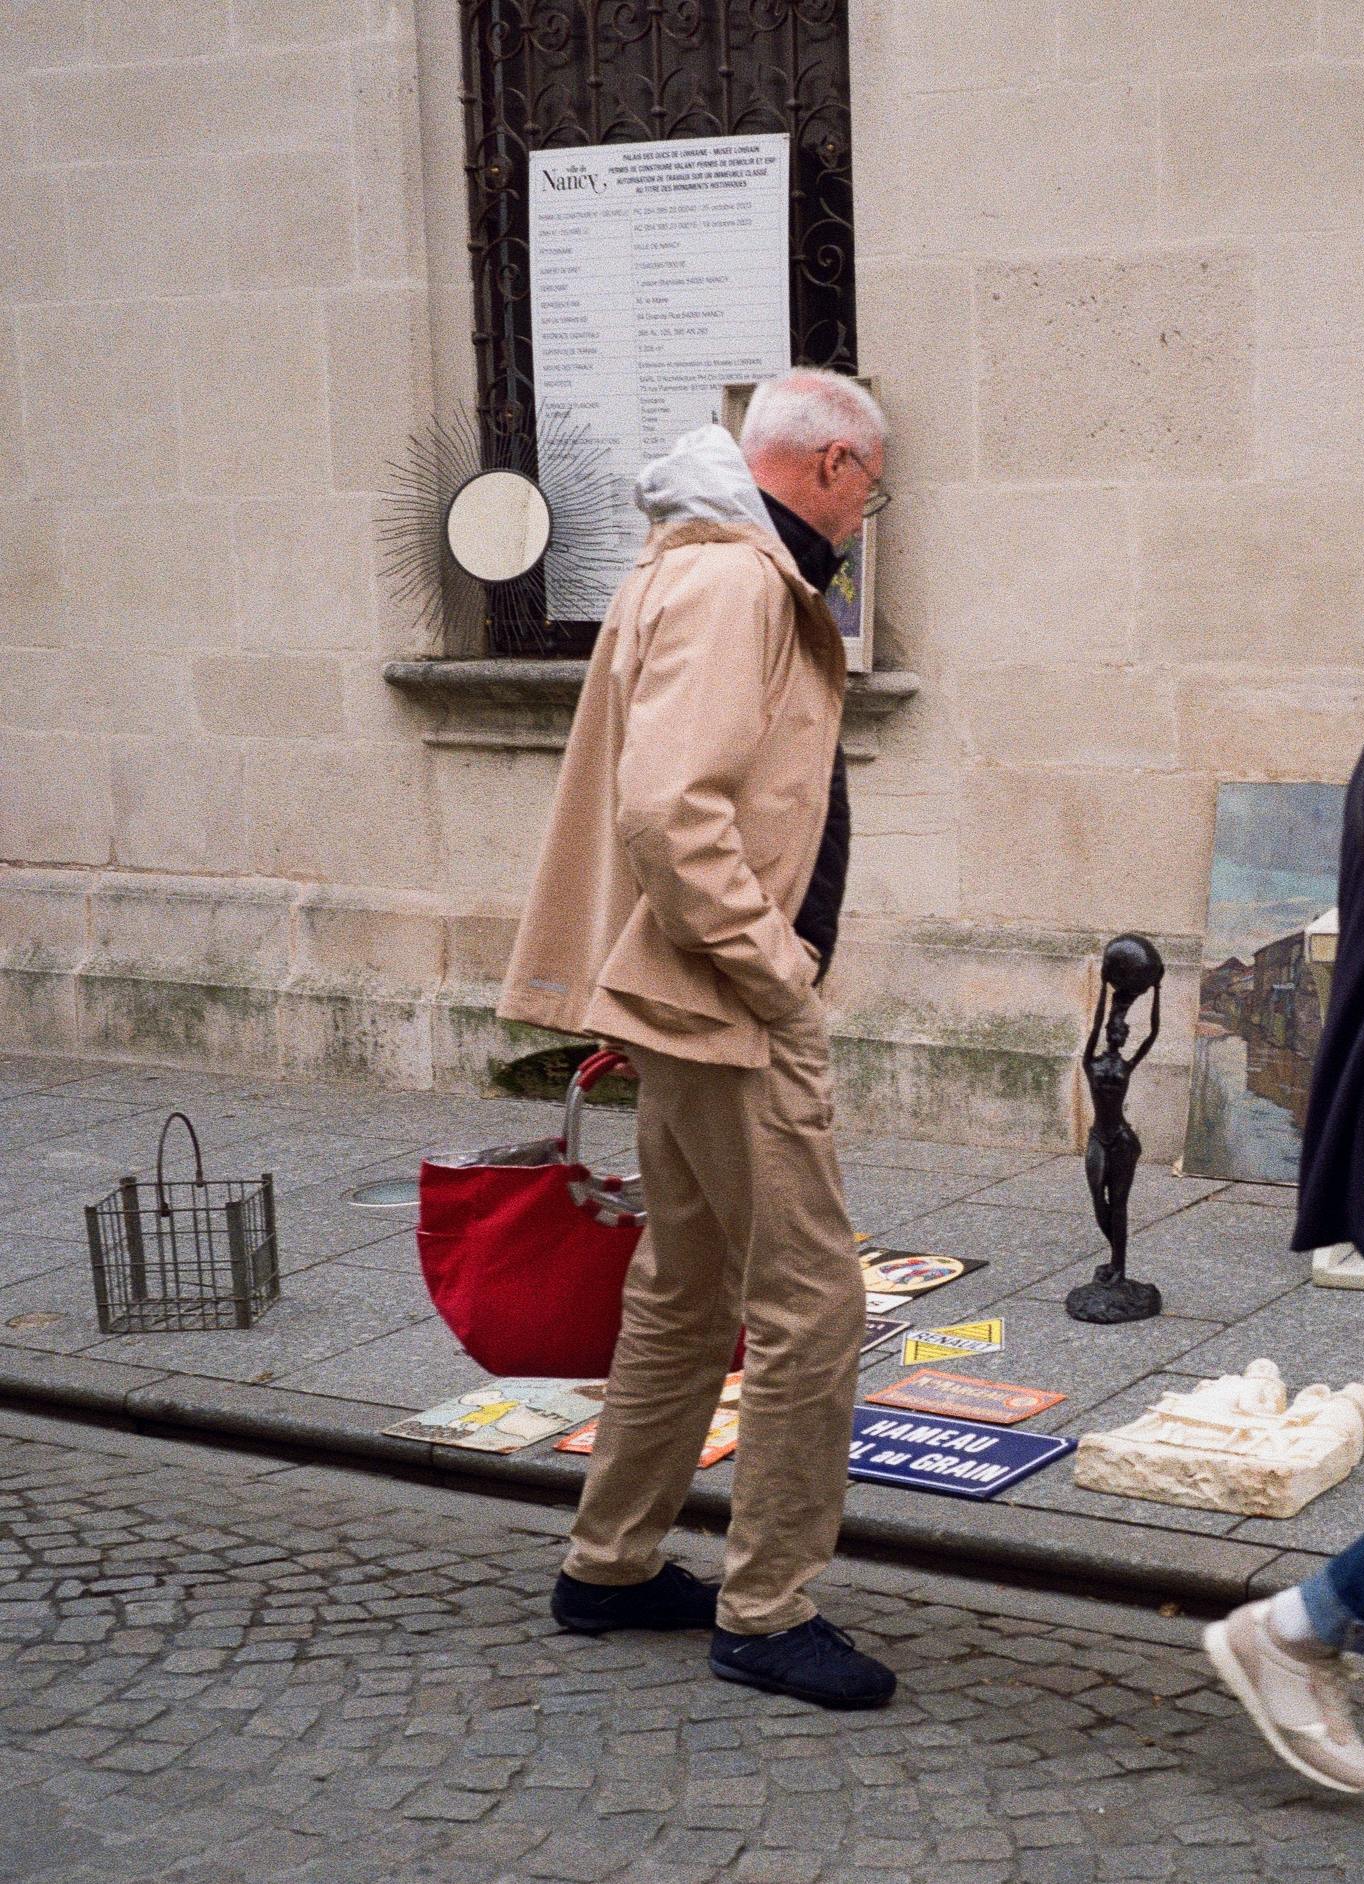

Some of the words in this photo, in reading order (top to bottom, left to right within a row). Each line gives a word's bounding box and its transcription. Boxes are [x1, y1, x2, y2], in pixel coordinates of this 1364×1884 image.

[542, 169, 607, 194] Nancy
[916, 1331, 992, 1350] RENAULT
[860, 1419, 999, 1453] HAMEAU
[870, 1451, 911, 1466] au
[909, 1452, 1010, 1483] GRAIN
